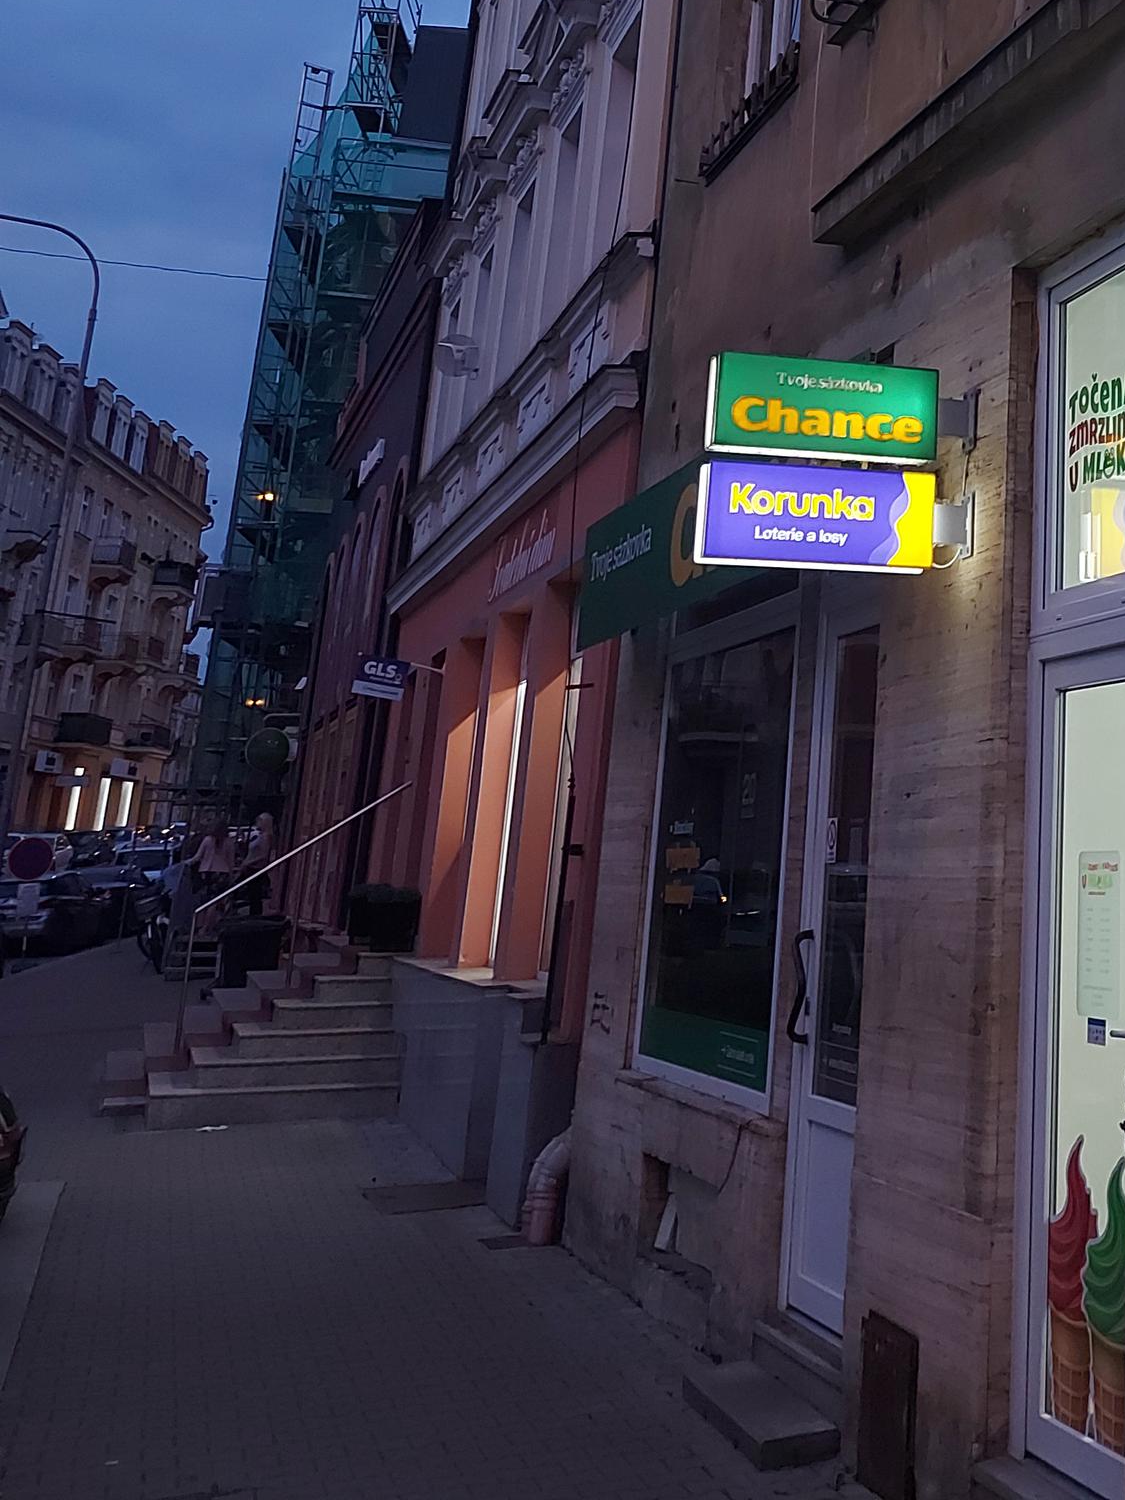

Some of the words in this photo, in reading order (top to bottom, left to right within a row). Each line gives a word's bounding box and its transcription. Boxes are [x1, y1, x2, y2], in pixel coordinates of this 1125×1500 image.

[777, 372, 816, 390] Tvoje
[731, 395, 924, 443] Chance
[1069, 460, 1079, 492] U
[729, 482, 875, 521] Korunka
[754, 525, 804, 542] Loterie
[806, 530, 817, 542] a
[819, 529, 848, 546] losy
[364, 661, 398, 678] GLS
